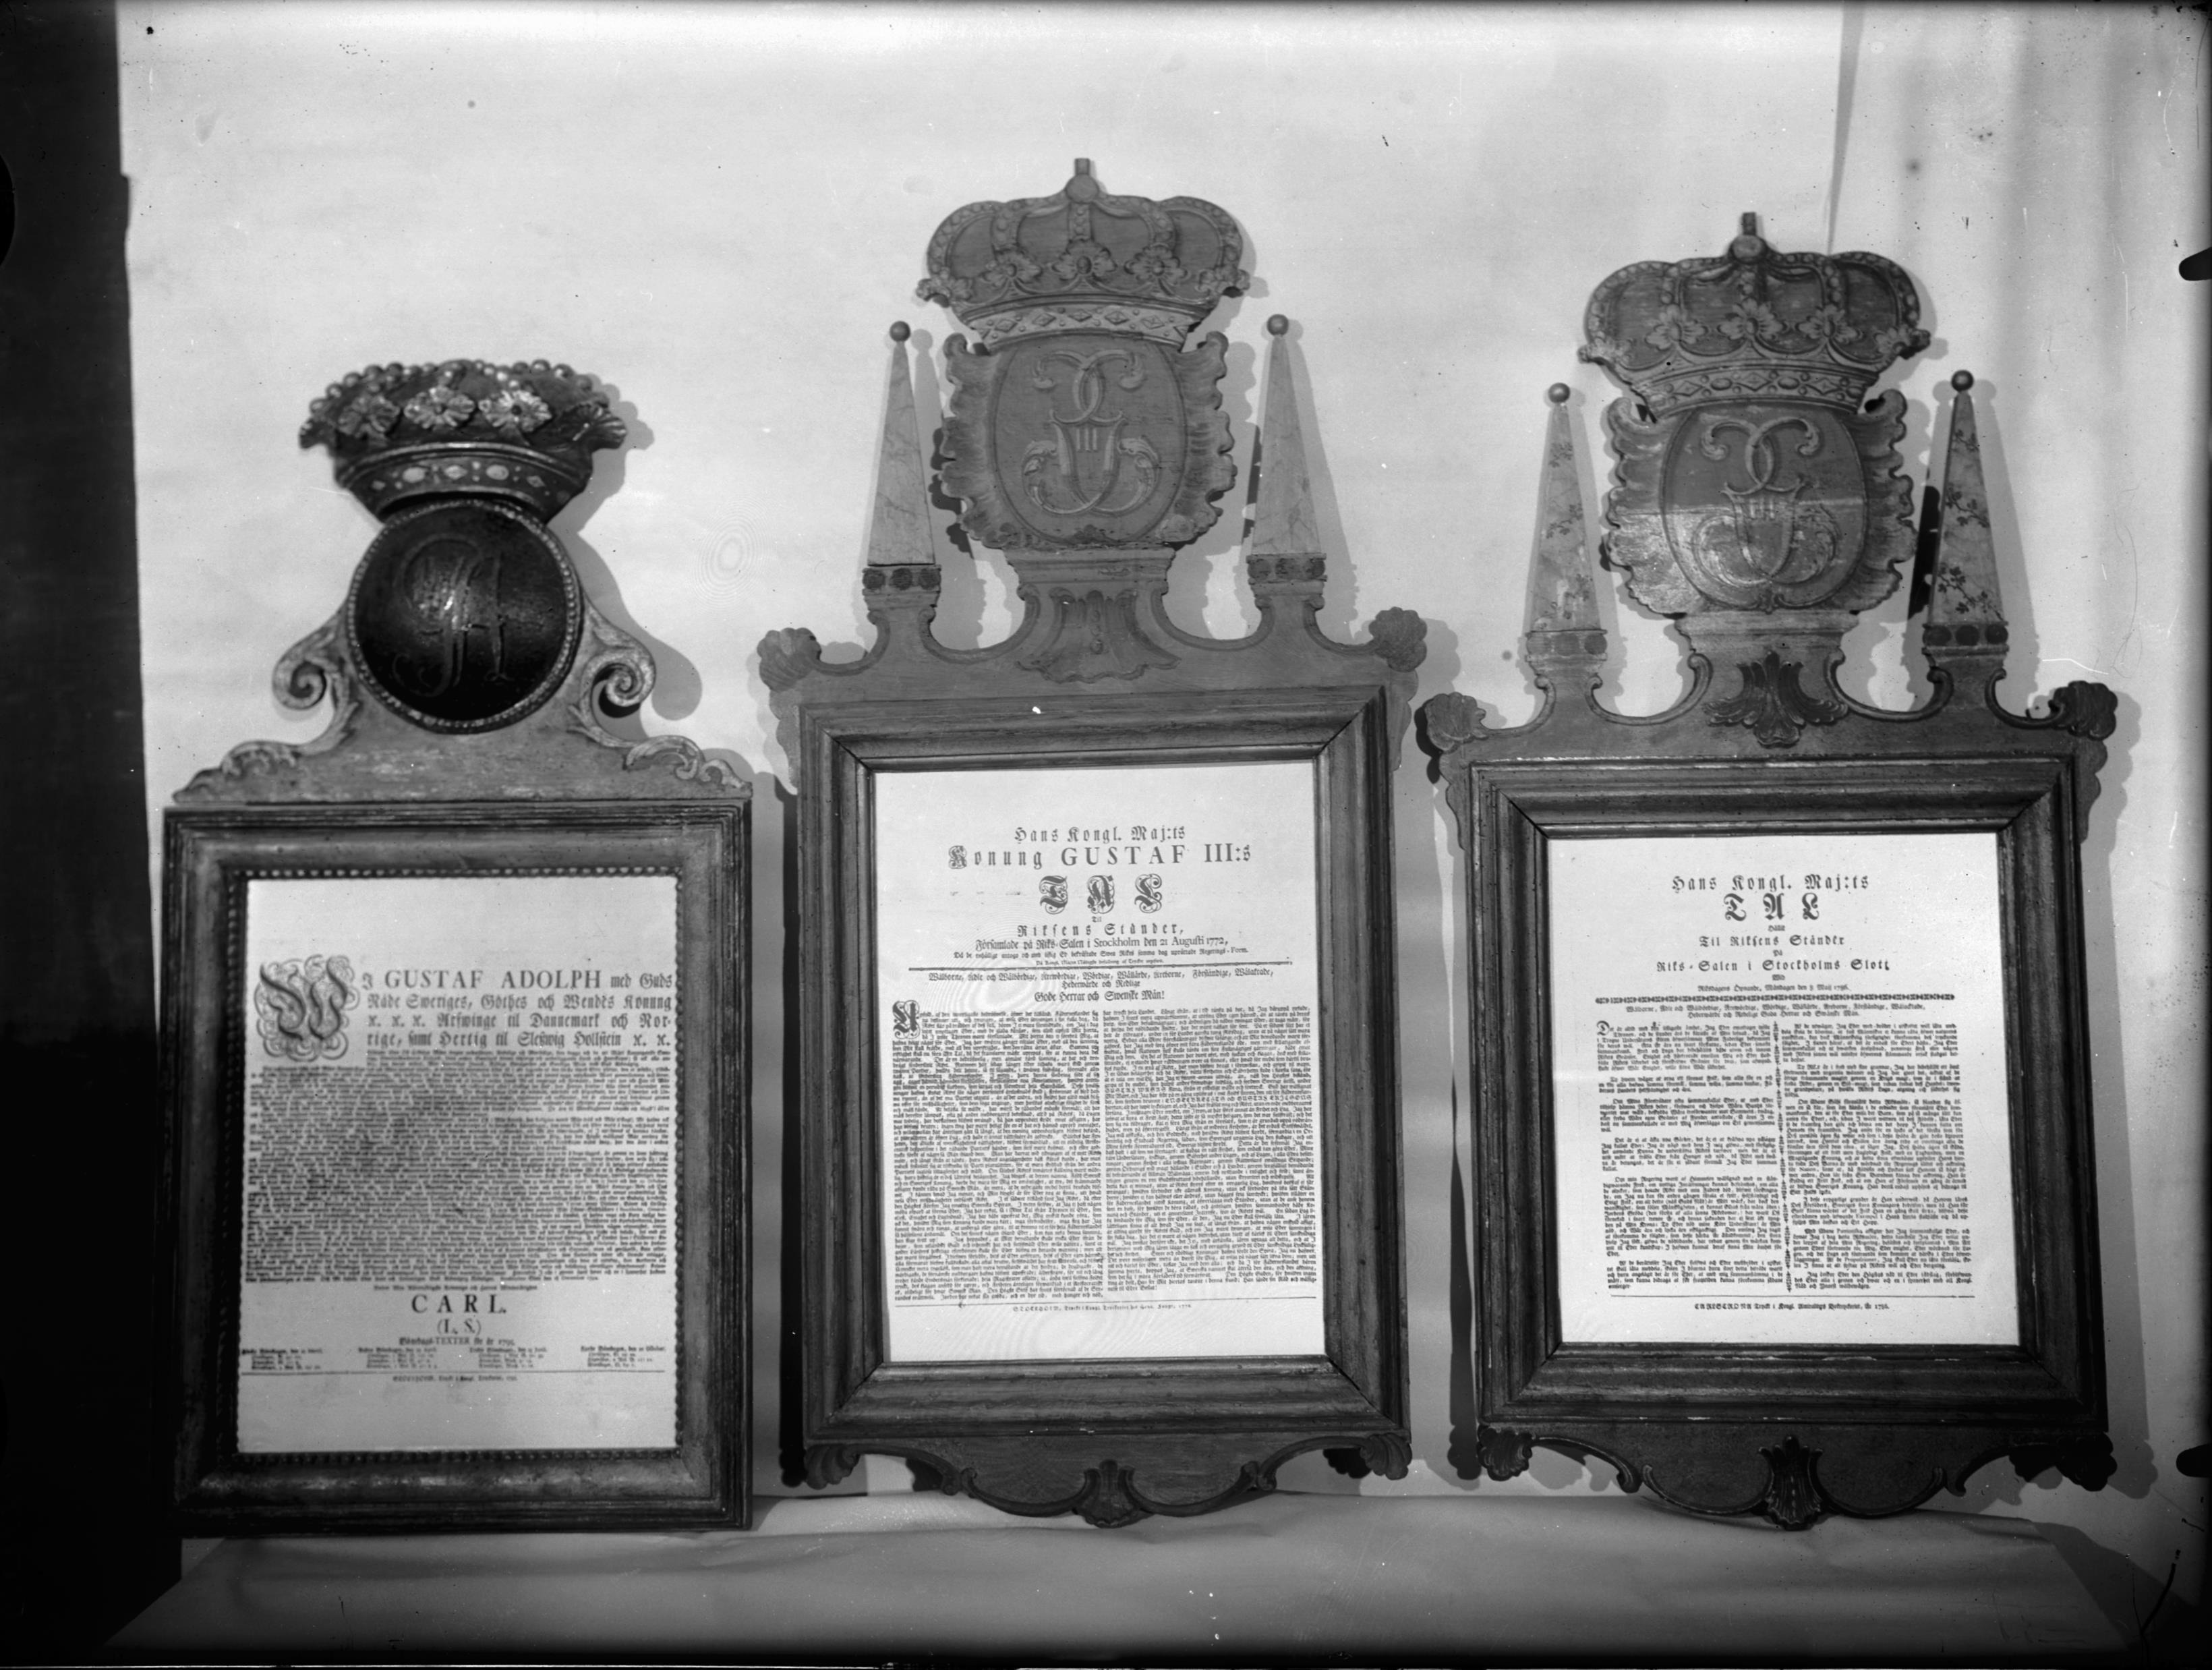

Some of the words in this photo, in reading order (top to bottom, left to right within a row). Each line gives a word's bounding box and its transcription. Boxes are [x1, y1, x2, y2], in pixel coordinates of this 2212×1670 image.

[1014, 828, 1058, 844] Hans
[1067, 826, 1122, 844] Kongl.
[949, 845, 1042, 869] Konung
[1061, 845, 1185, 866] GUSTAF
[1672, 876, 1717, 894] Hans
[1732, 875, 1792, 893] Kongl.
[1095, 938, 1140, 947] Stockholm
[1144, 938, 1157, 947] den
[384, 970, 483, 989] GUSTAF
[501, 970, 601, 989] ADOLPH
[538, 994, 554, 1011] och
[1088, 991, 1099, 1002] och
[612, 1013, 628, 1029] och
